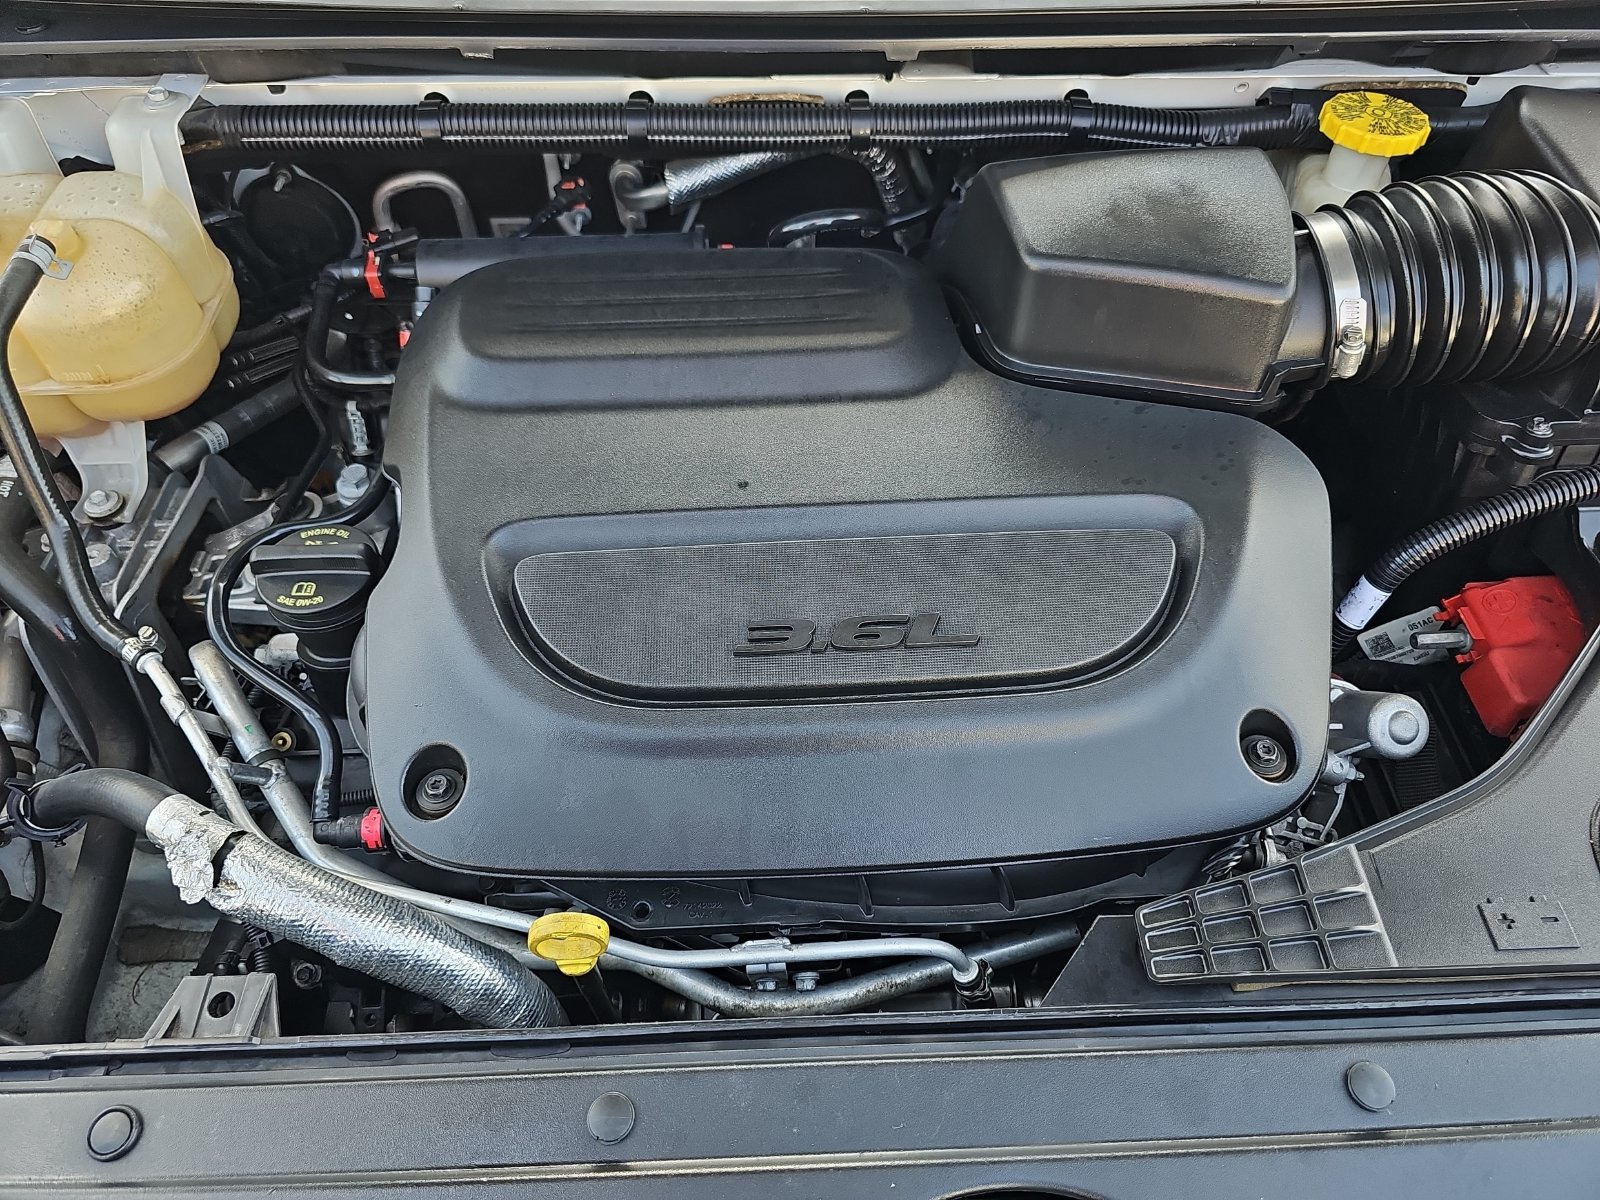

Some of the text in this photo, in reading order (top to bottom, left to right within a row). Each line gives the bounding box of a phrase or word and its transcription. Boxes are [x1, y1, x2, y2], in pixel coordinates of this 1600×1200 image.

[300, 527, 351, 539] ENGINE OIL
[276, 595, 324, 607] SAE 0W-20
[1407, 616, 1434, 632] 051AC
[733, 611, 981, 657] 3.6L
